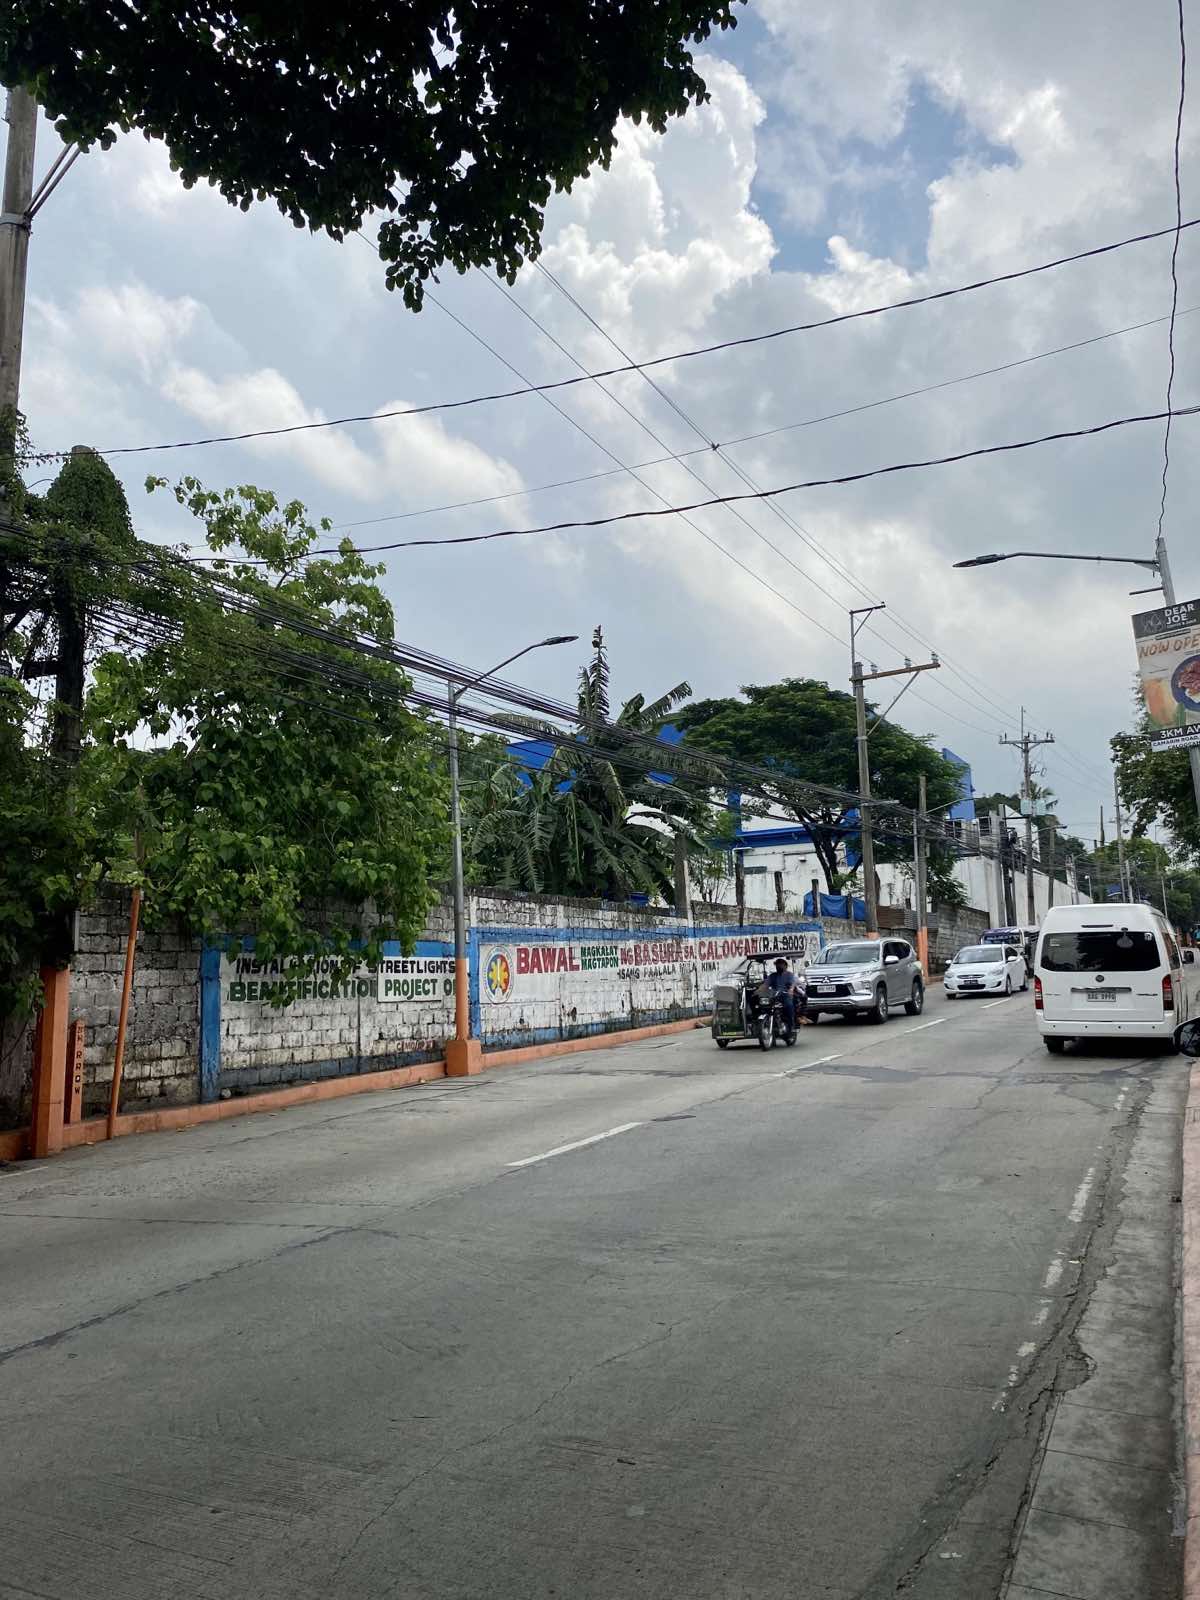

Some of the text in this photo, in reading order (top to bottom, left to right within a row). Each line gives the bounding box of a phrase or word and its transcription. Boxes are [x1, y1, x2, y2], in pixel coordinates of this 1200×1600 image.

[1164, 603, 1194, 617] DEAR
[1166, 613, 1189, 625] JOE
[1139, 641, 1169, 658] NOW
[1159, 727, 1183, 739] 3KM
[581, 945, 618, 958] MAGKALAT
[621, 949, 634, 966] NG
[634, 941, 683, 967] BASURA
[236, 957, 338, 975] INSTALION
[516, 946, 580, 974] BAWAL
[581, 957, 619, 971] MAGTAPON
[644, 964, 676, 978] PAALALA
[384, 978, 438, 1001] PROJECT
